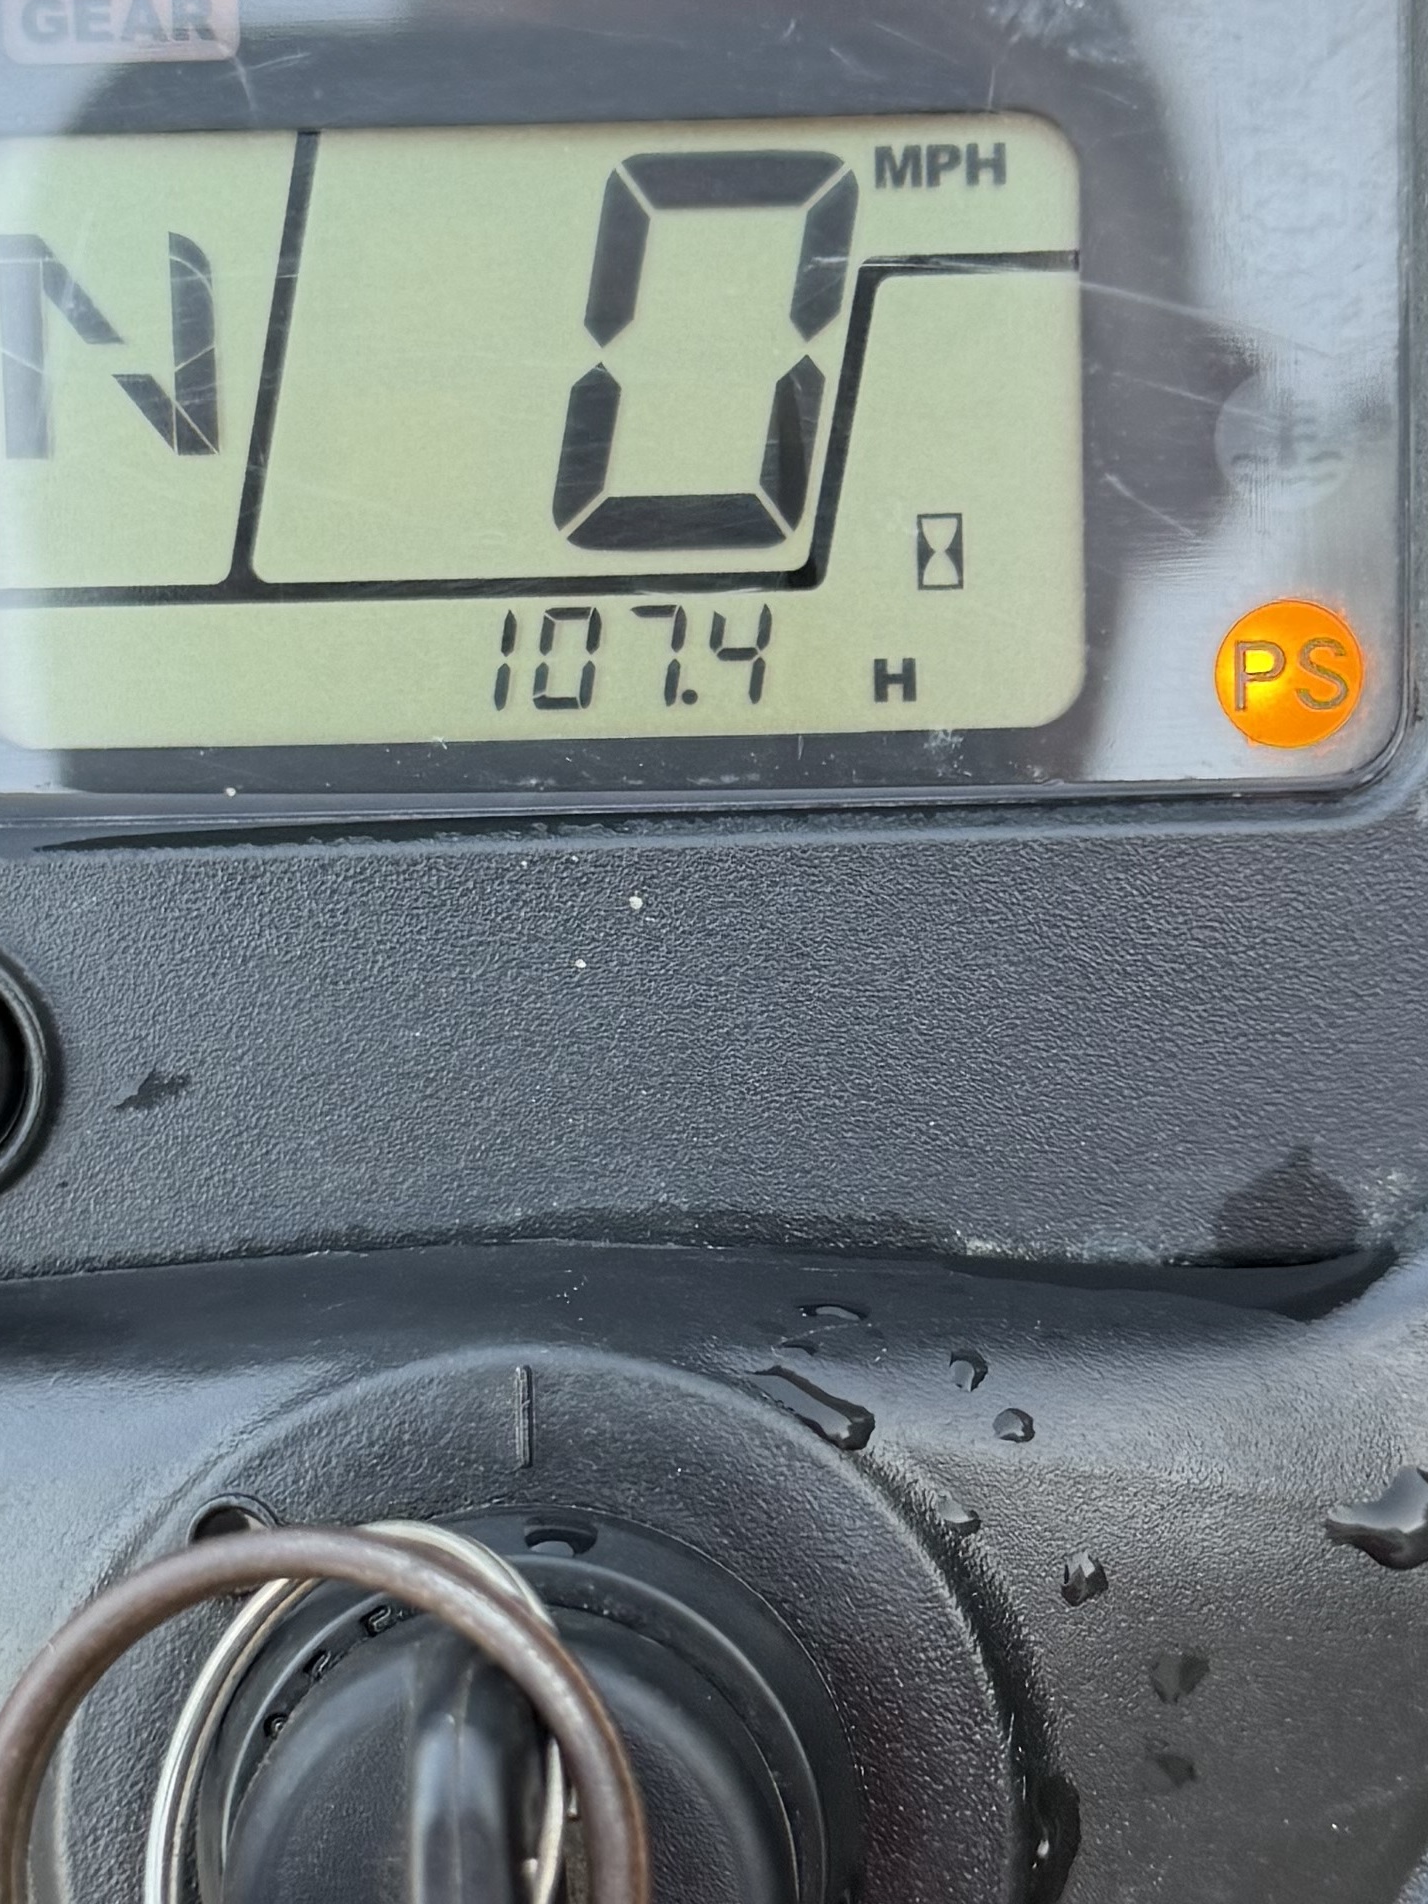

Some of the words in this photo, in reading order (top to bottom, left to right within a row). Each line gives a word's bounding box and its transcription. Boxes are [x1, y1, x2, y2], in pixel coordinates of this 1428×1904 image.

[874, 142, 1007, 189] MPH
[552, 149, 859, 551] 0
[494, 603, 772, 711] 107.4
[873, 658, 917, 702] H
[1231, 637, 1350, 712] PS
